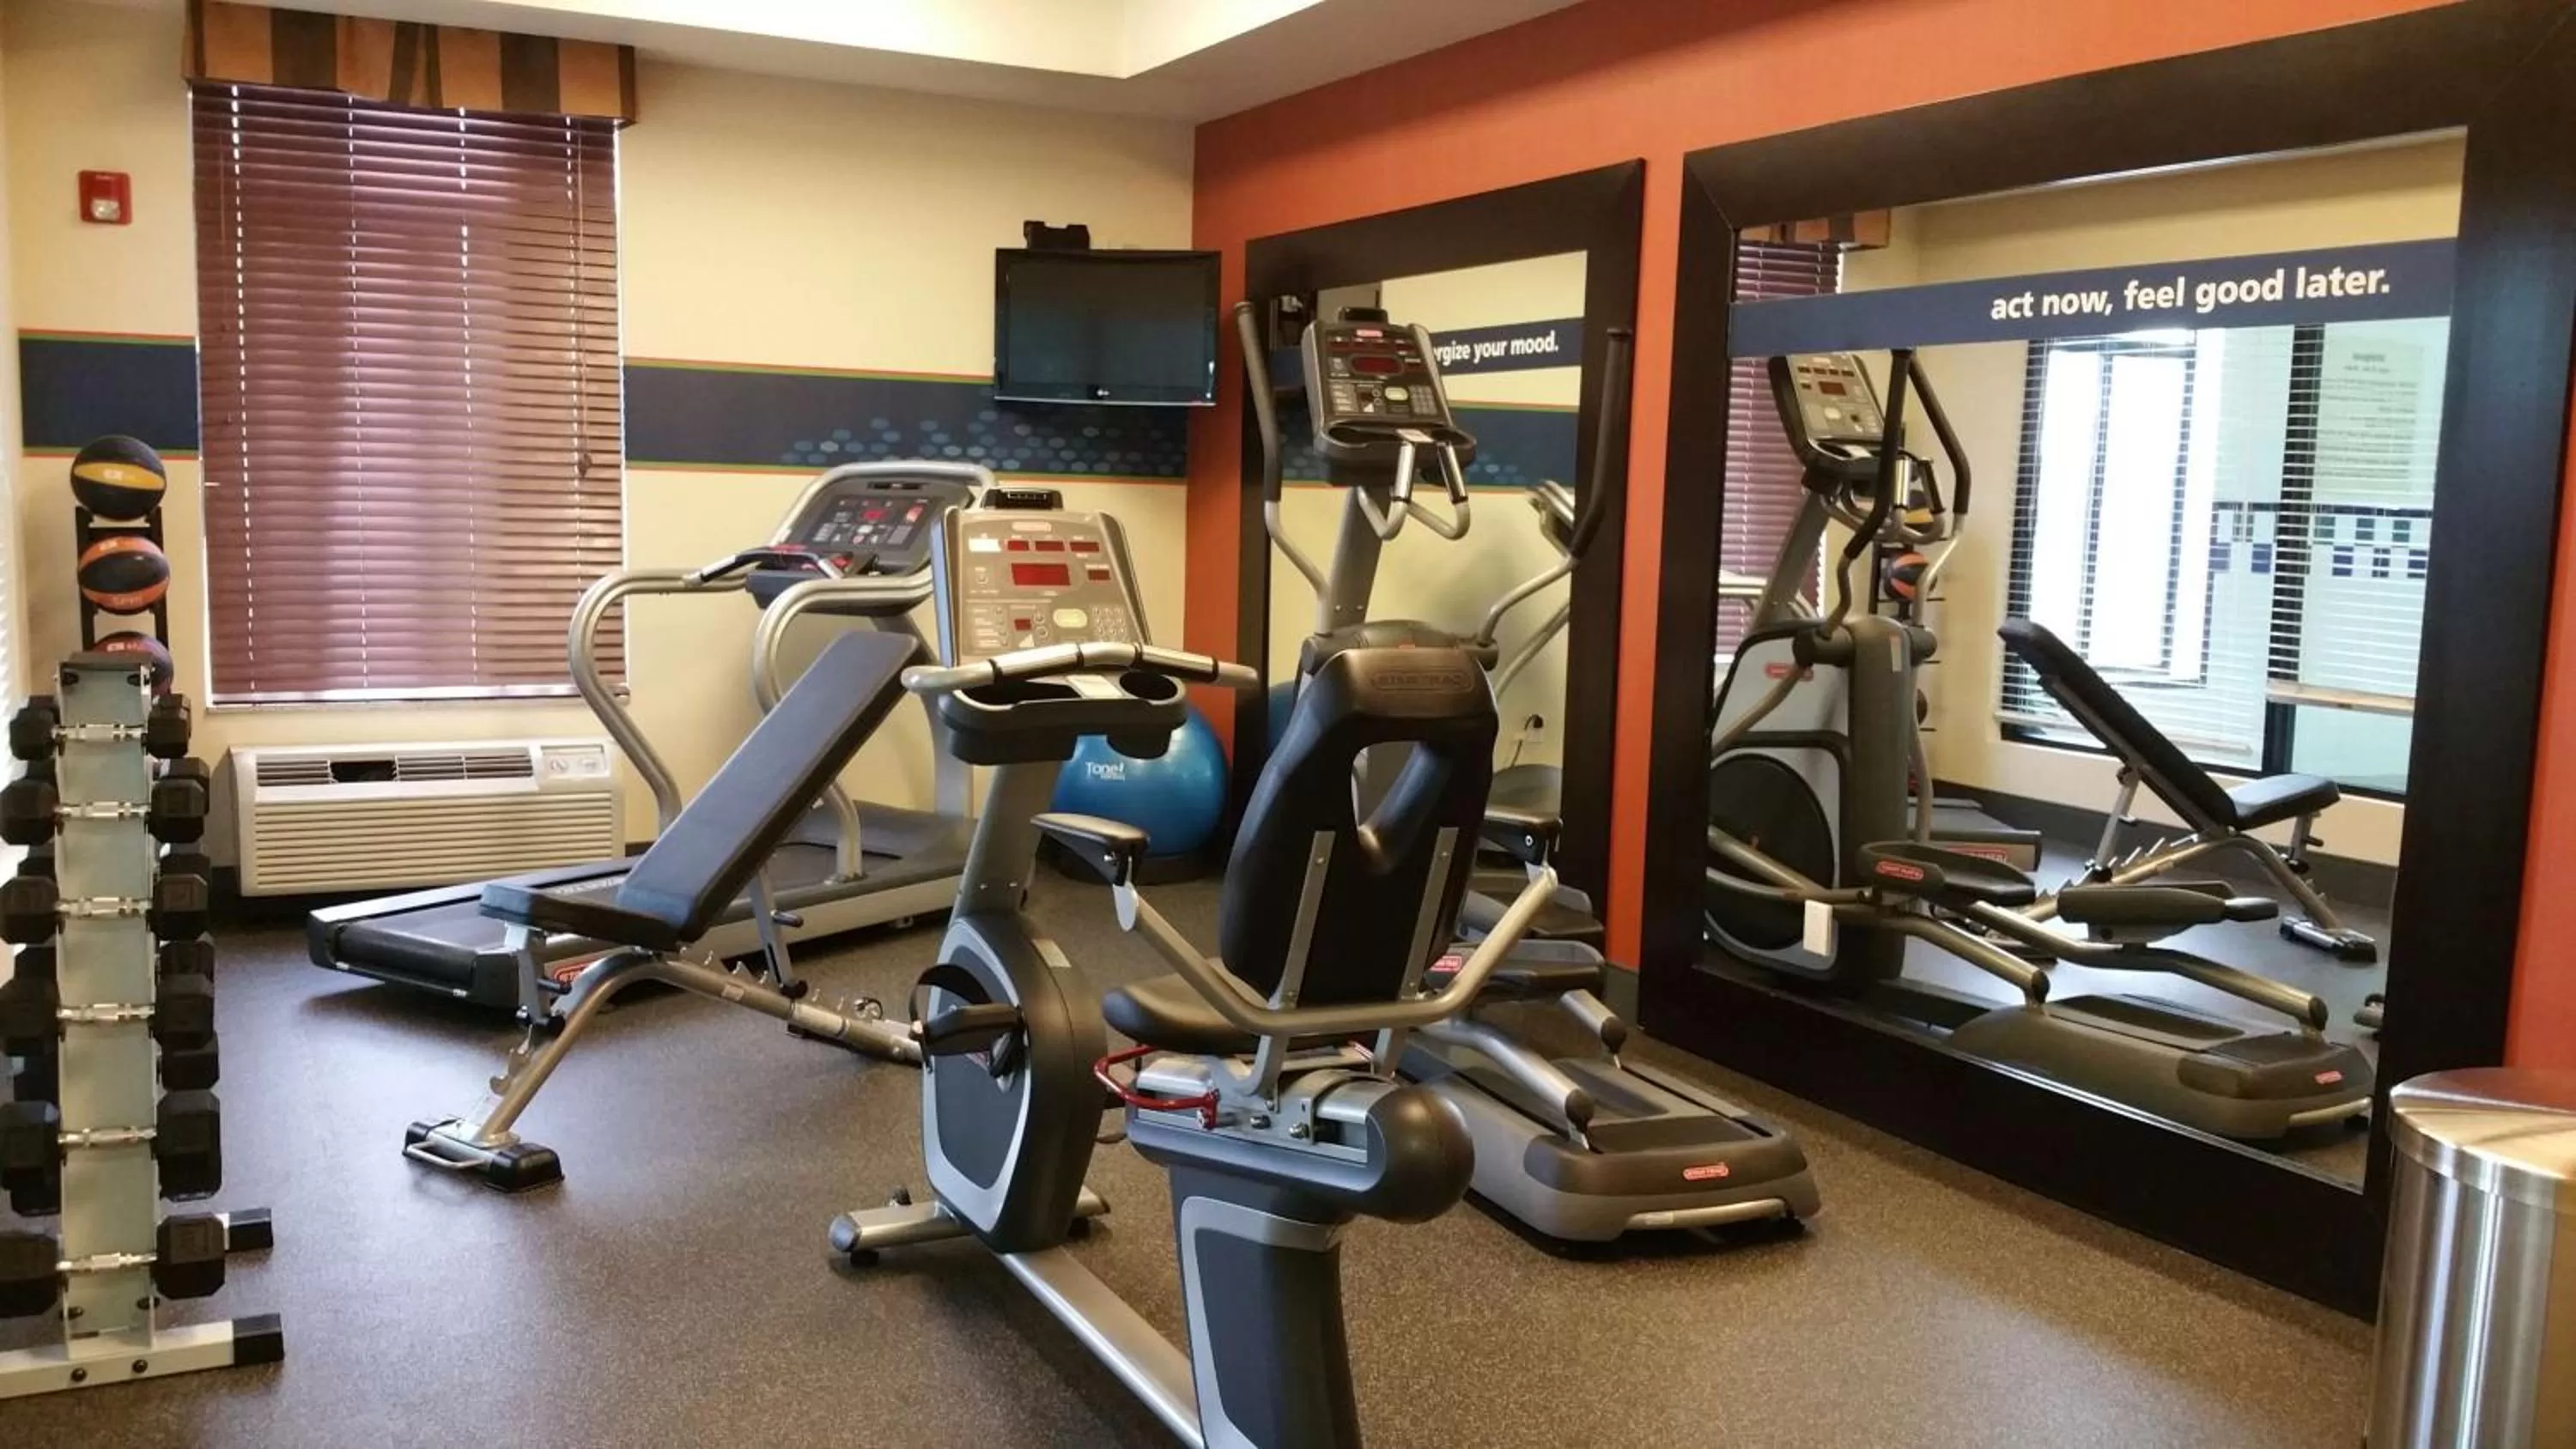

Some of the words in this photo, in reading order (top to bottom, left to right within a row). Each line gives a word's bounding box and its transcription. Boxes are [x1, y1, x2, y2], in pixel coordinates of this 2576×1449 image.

[1991, 292, 2033, 320] act
[2041, 290, 2113, 316] now,
[2123, 276, 2185, 311] feel
[2195, 269, 2284, 312] good
[2295, 266, 2390, 299] later.
[1473, 340, 1509, 364] your
[1510, 330, 1558, 354] mood.
